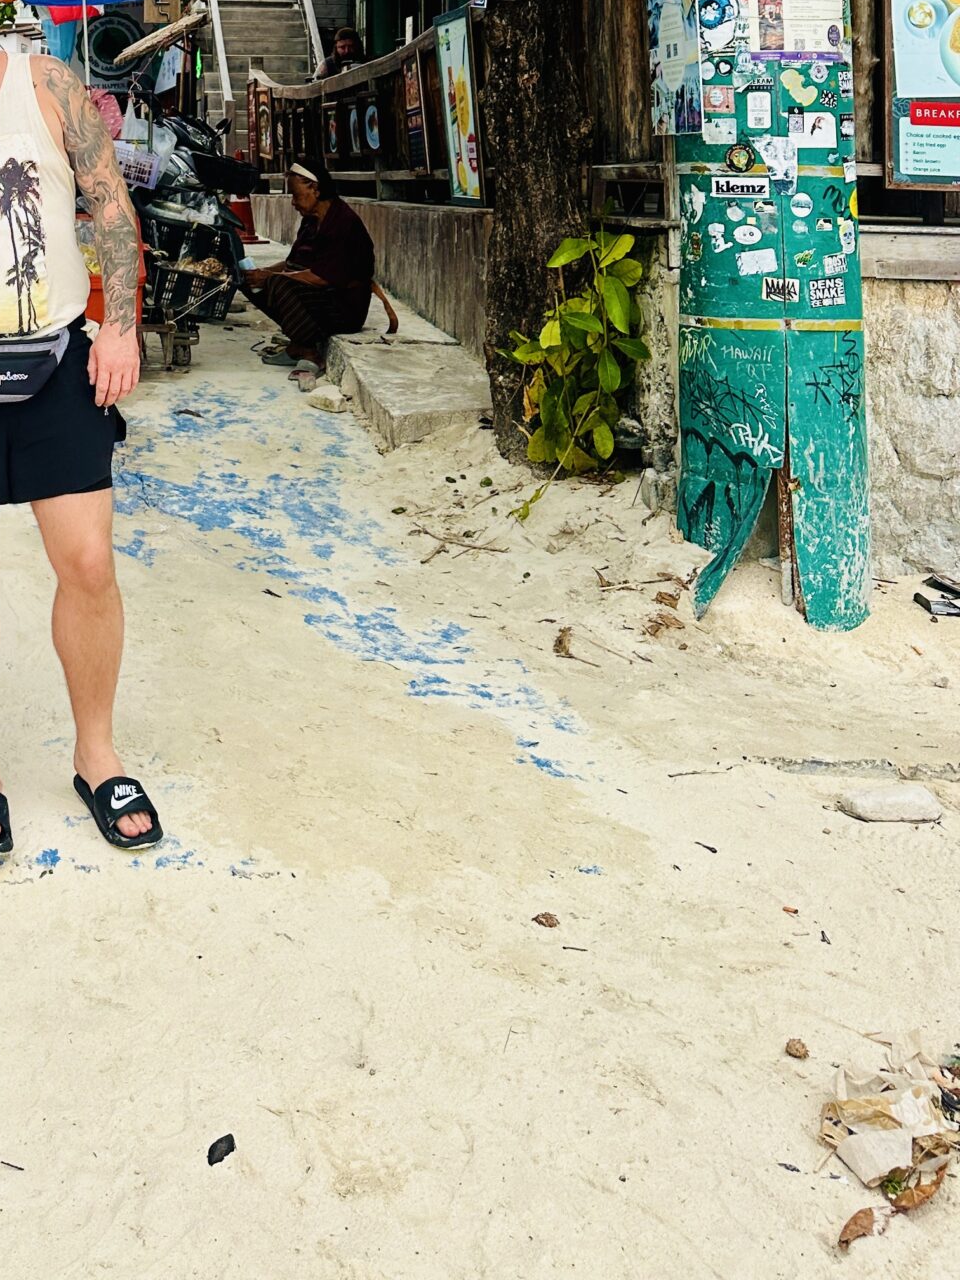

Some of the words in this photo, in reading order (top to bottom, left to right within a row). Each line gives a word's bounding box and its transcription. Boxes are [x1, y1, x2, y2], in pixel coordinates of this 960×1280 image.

[715, 180, 766, 194] klemz
[810, 277, 844, 290] DENS
[810, 286, 845, 301] SNAKE
[113, 784, 139, 798] NIKE
